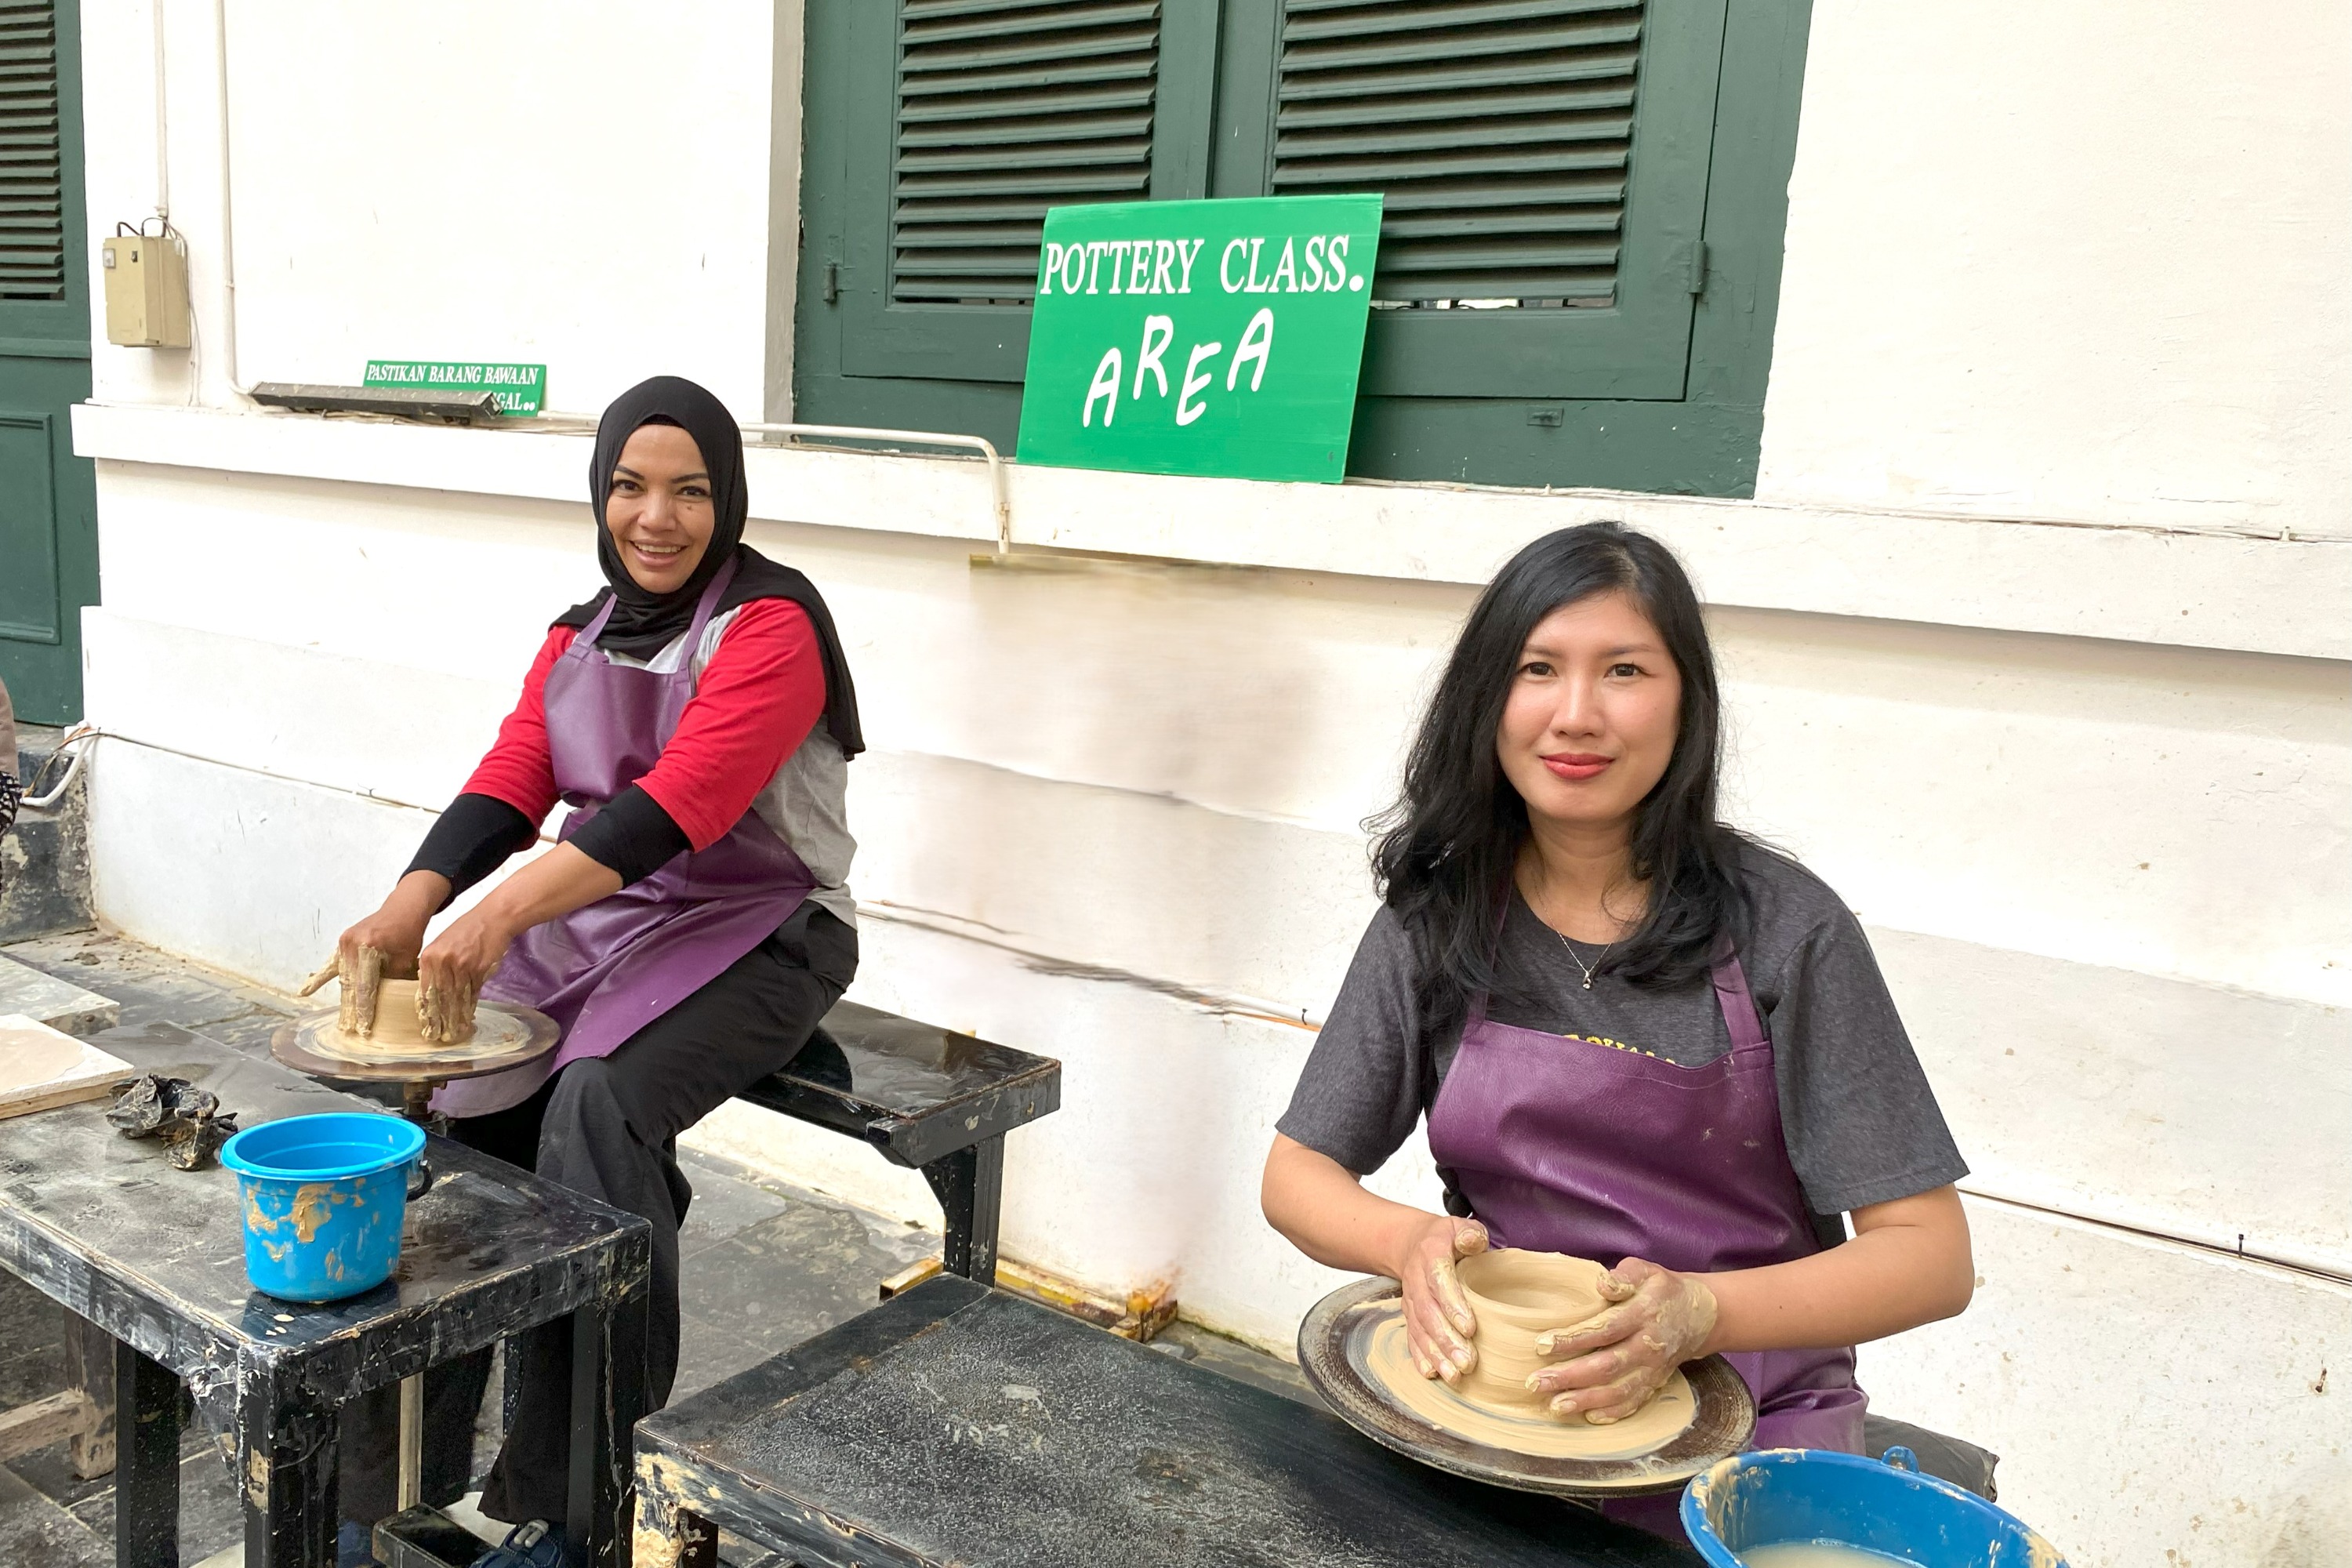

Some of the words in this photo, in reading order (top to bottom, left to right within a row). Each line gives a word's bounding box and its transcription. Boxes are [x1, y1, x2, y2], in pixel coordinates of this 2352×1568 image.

[1040, 238, 1205, 295] POTTERY
[1220, 235, 1364, 294] CLASS.
[366, 364, 427, 383] PASTIKAN
[428, 365, 482, 384] BARANG
[483, 367, 539, 385] BAWAAN
[1082, 307, 1274, 428] AREA
